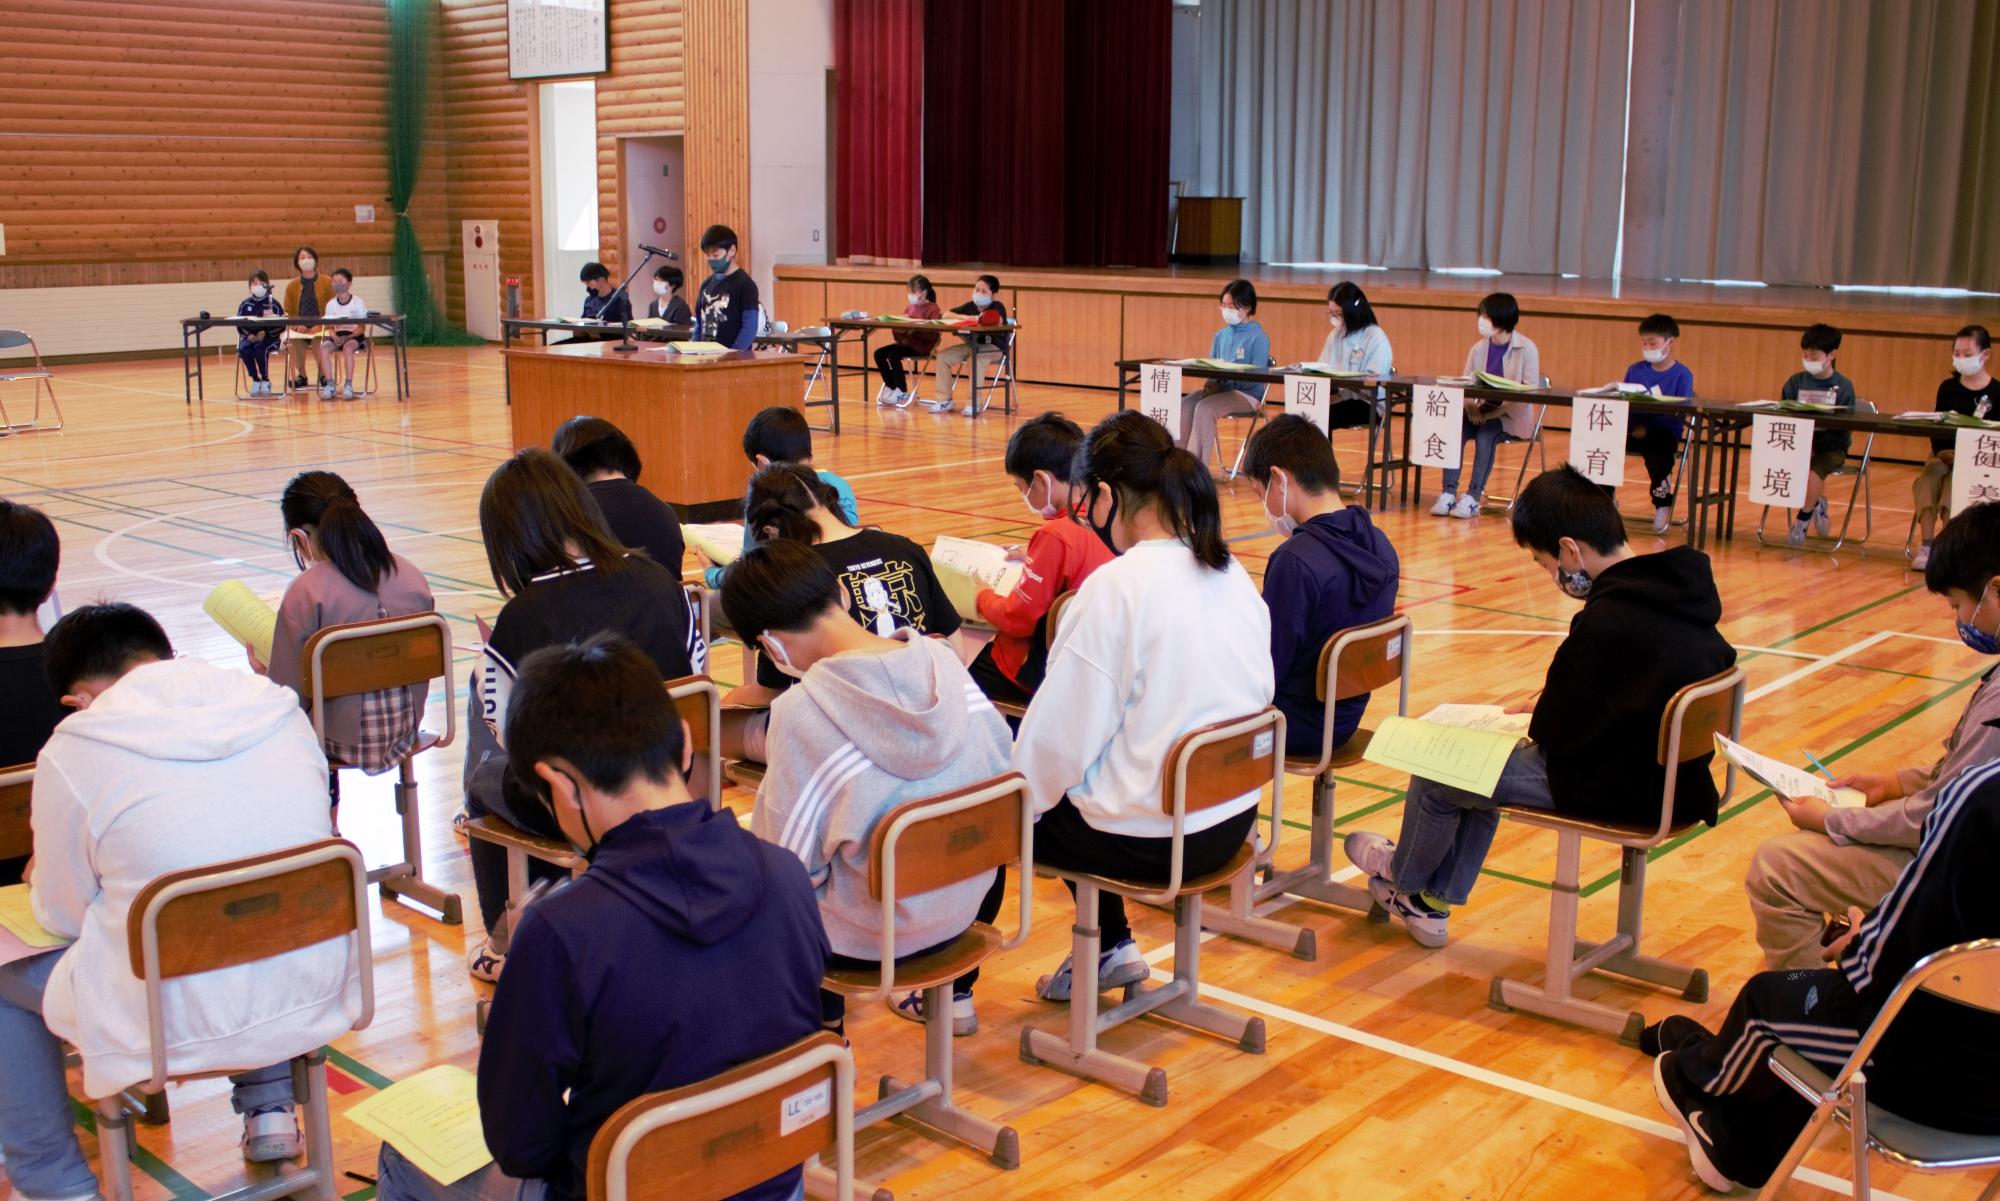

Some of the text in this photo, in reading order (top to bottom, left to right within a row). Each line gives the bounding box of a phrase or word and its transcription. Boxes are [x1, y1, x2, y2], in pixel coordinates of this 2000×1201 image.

[1150, 368, 1171, 427] 情報
[1424, 390, 1450, 460] 給食
[1586, 403, 1613, 477] 体育
[1762, 421, 1798, 498] 環境
[1967, 434, 2000, 503] 保健・美
